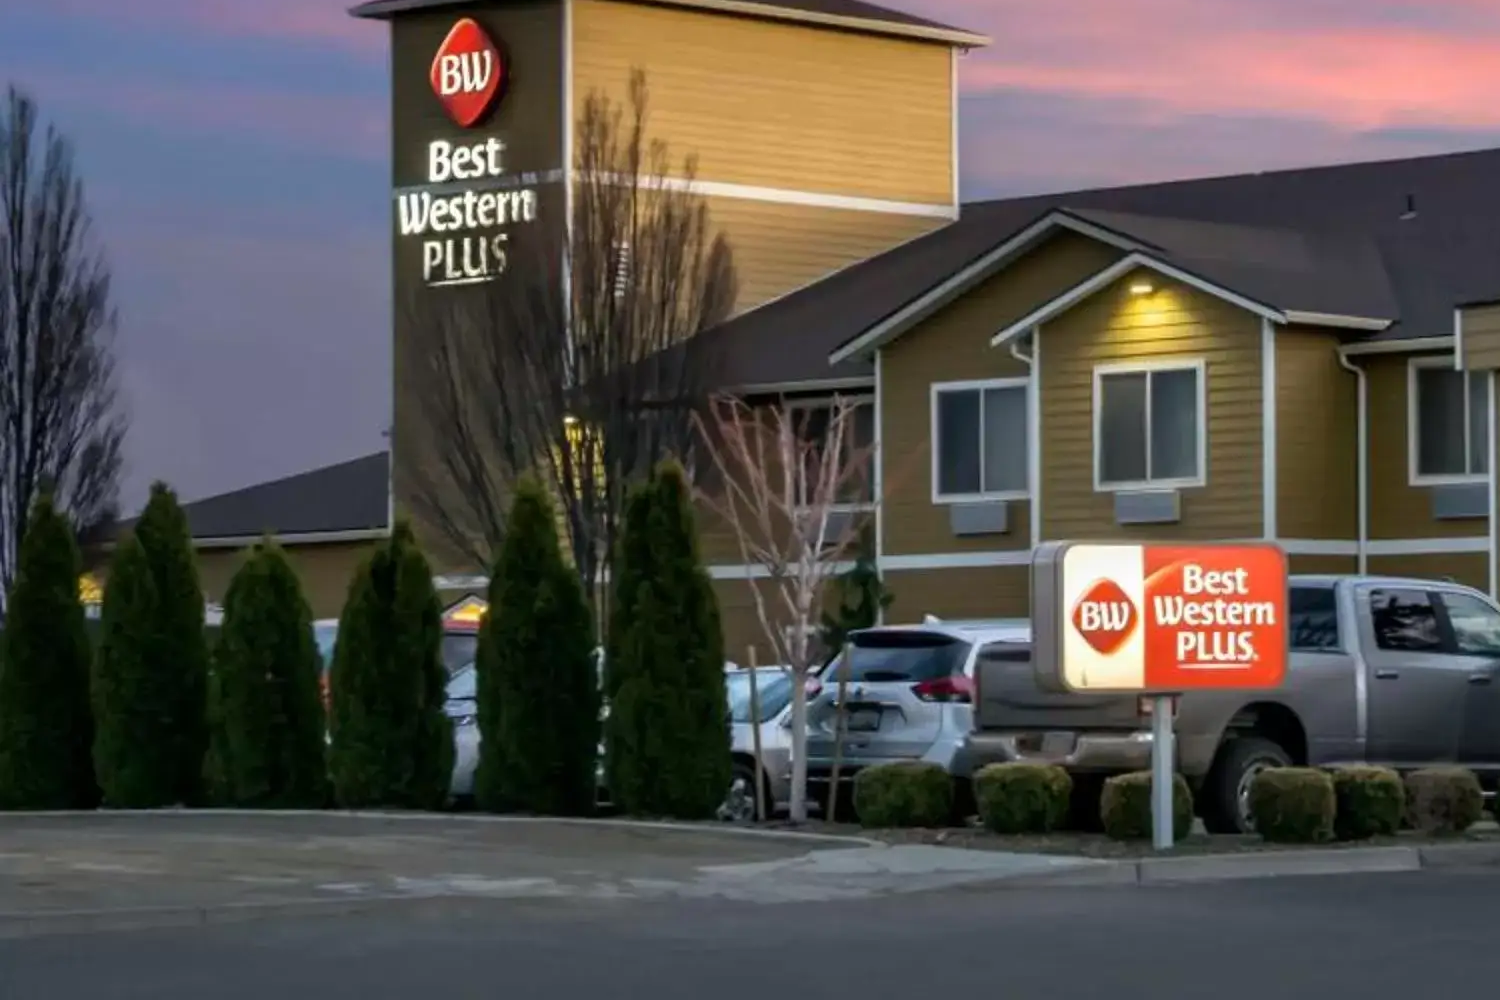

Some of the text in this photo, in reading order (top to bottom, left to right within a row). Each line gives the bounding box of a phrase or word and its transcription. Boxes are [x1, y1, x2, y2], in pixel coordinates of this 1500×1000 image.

[440, 50, 491, 95] BW
[429, 138, 505, 182] Best
[399, 189, 537, 235] Western
[422, 233, 508, 281] PLUS
[1183, 564, 1248, 595] Best
[1081, 602, 1129, 631] BW
[1154, 595, 1275, 626] Western
[1177, 631, 1254, 661] PLUS
